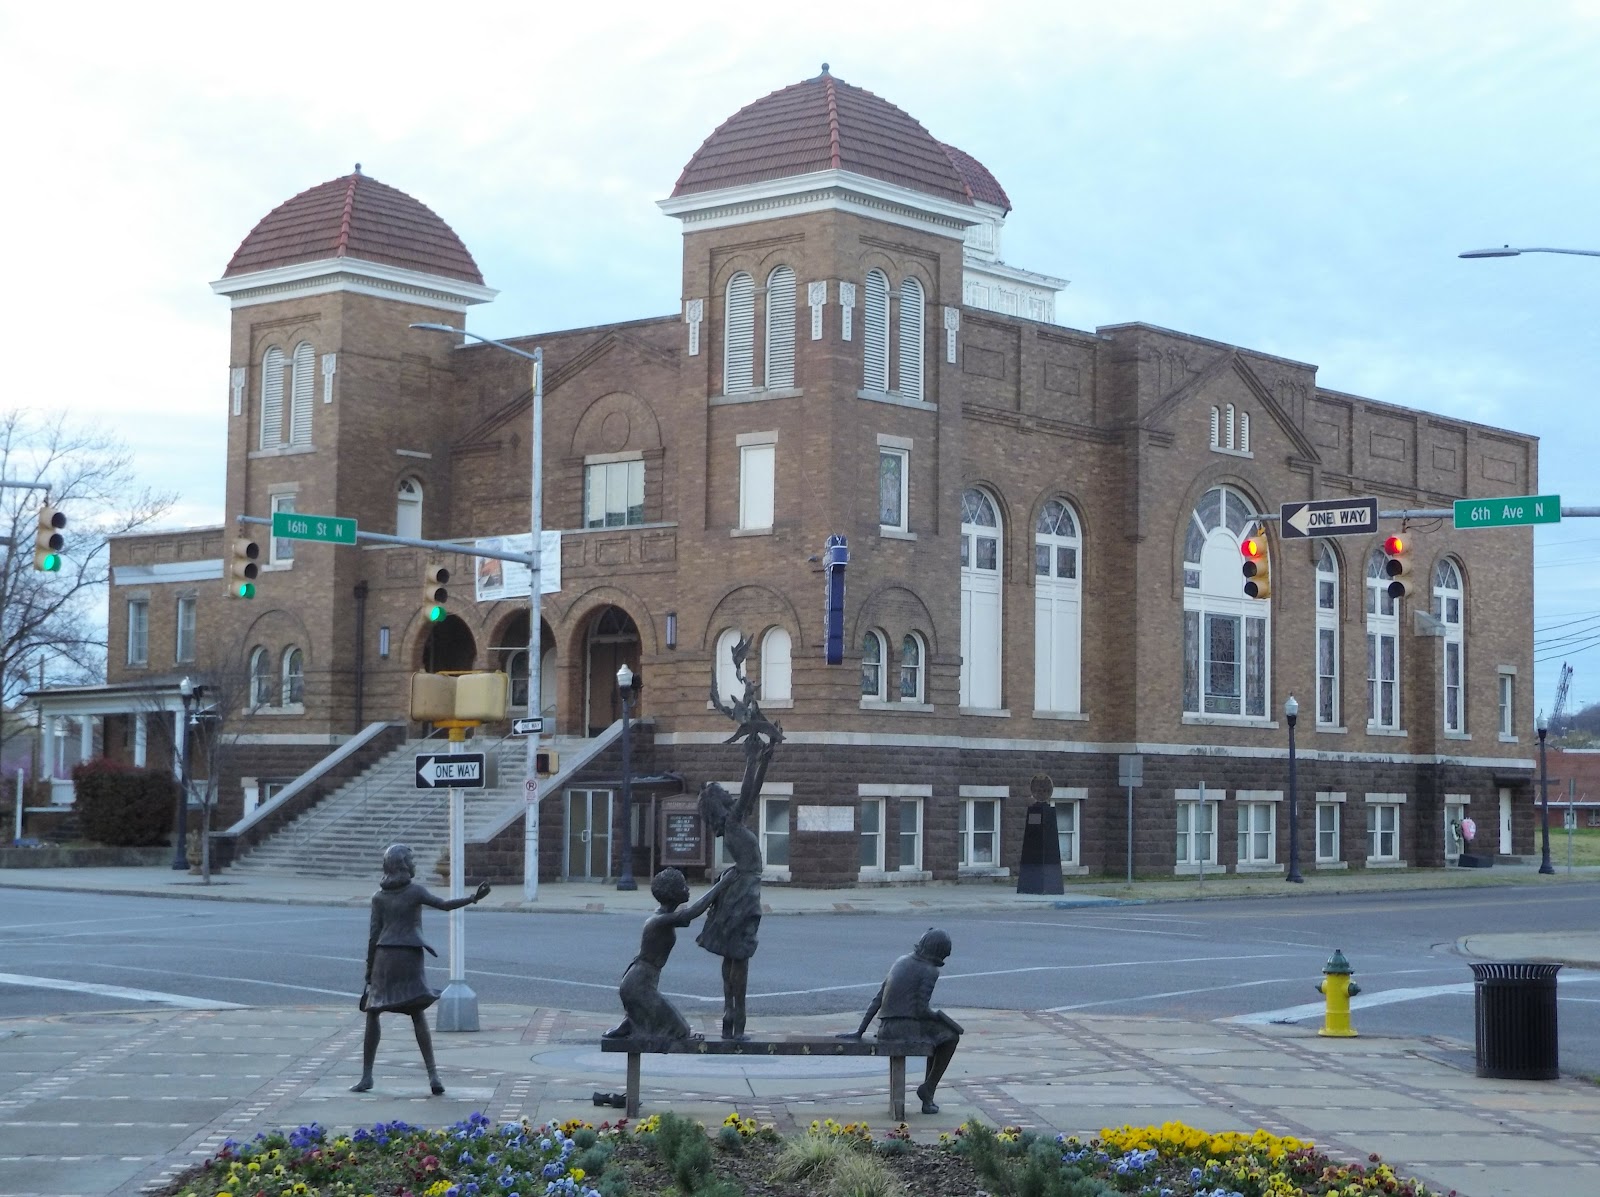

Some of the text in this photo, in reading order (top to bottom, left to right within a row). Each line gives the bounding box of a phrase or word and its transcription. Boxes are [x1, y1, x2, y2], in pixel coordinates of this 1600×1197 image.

[1309, 509, 1366, 526] ONE WAY
[1471, 503, 1544, 521] 6th Ave N
[287, 520, 343, 537] 16th St N
[435, 764, 477, 778] ONE WAY
